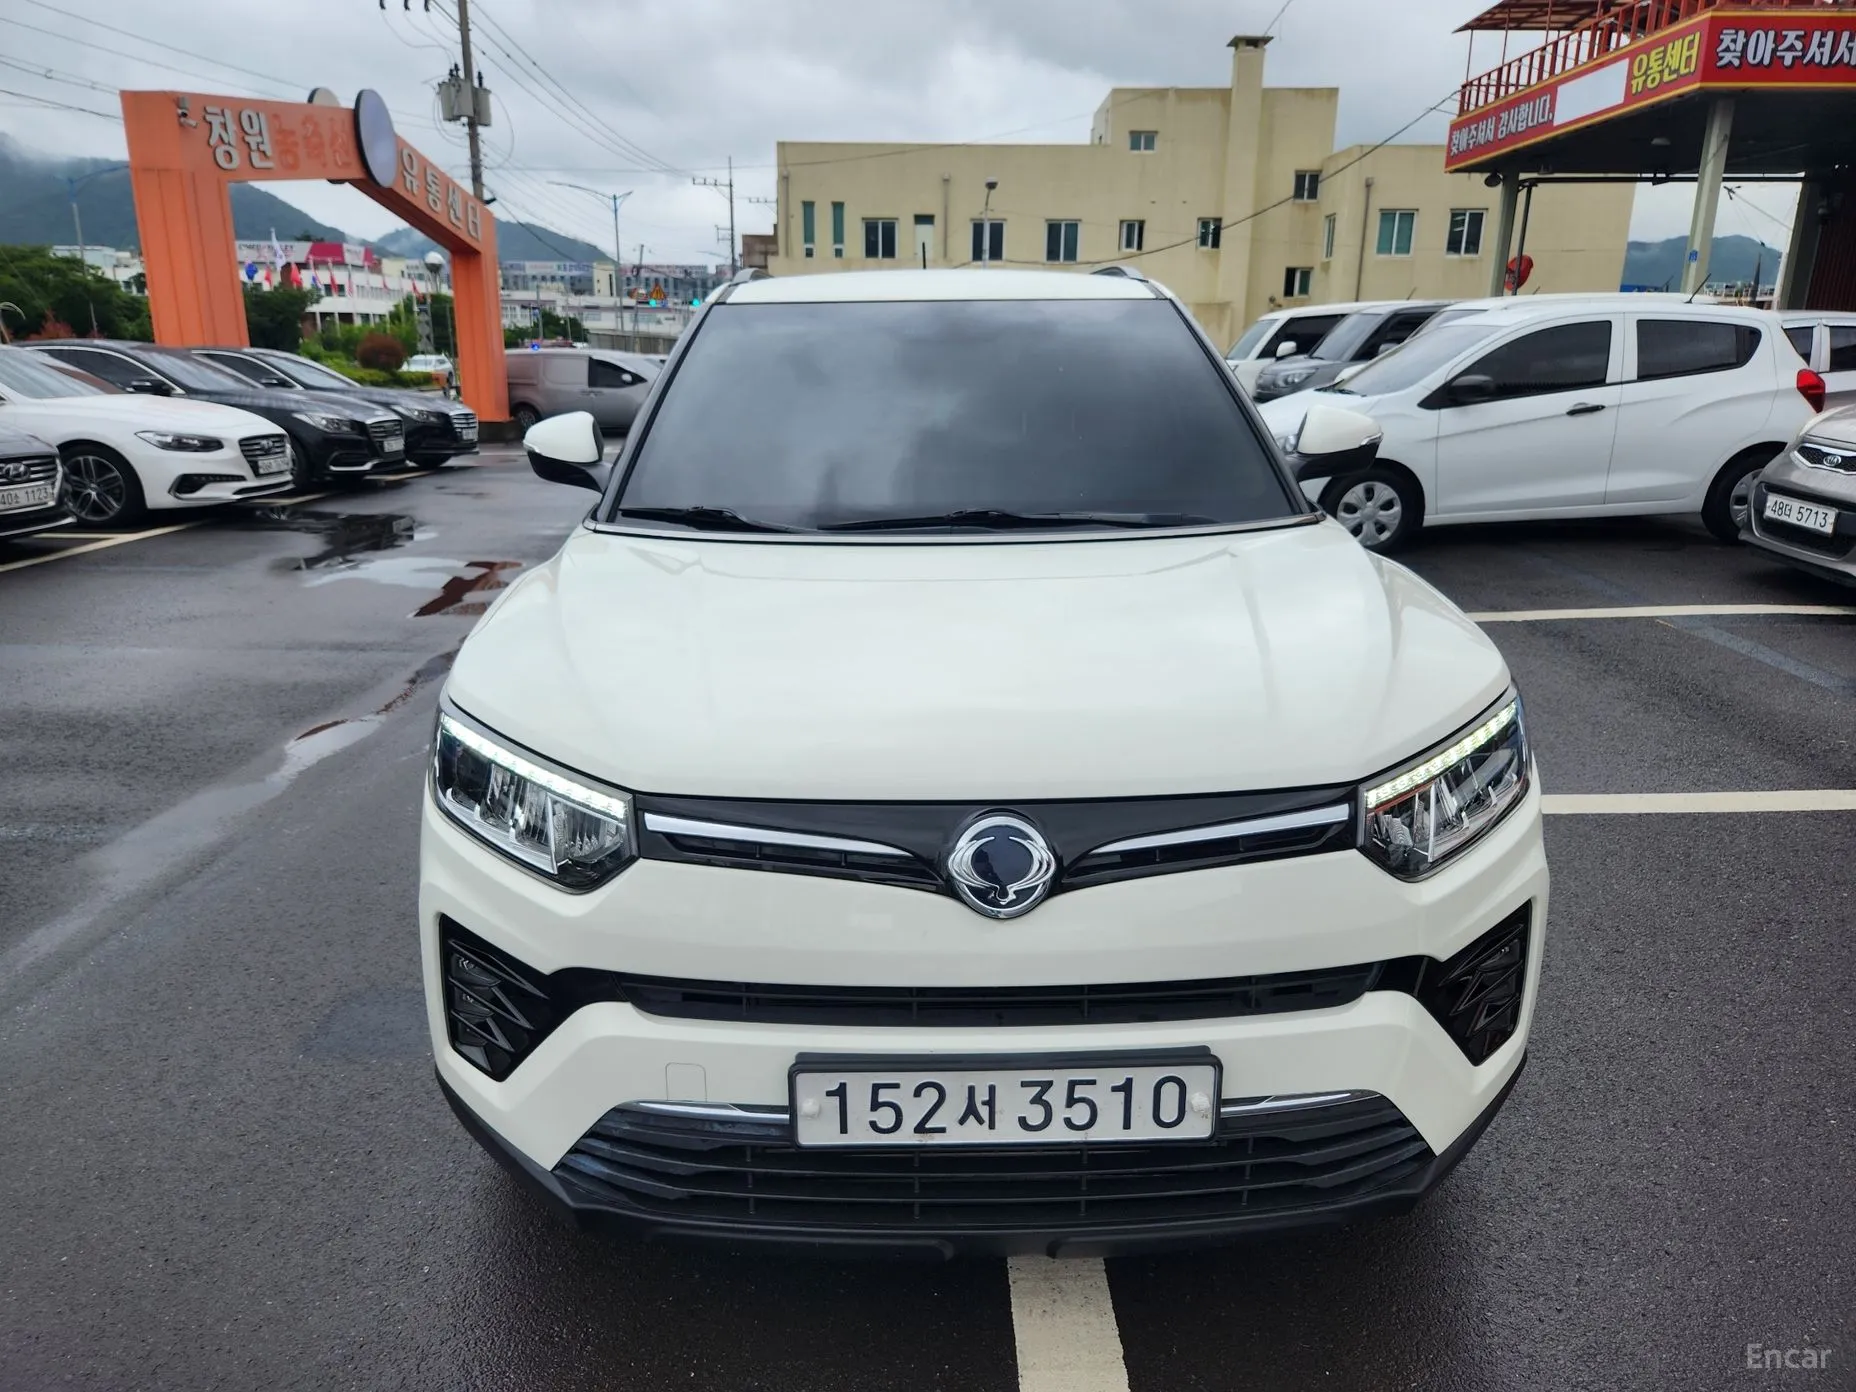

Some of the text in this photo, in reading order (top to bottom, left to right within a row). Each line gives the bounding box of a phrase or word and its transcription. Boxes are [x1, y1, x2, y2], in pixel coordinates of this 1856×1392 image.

[1631, 32, 1700, 94] 유통센터
[1497, 93, 1553, 141] 감사합니다.
[401, 146, 482, 242] 유통센터
[1796, 506, 1828, 528] 5713
[824, 1074, 1188, 1135] 152서 3510
